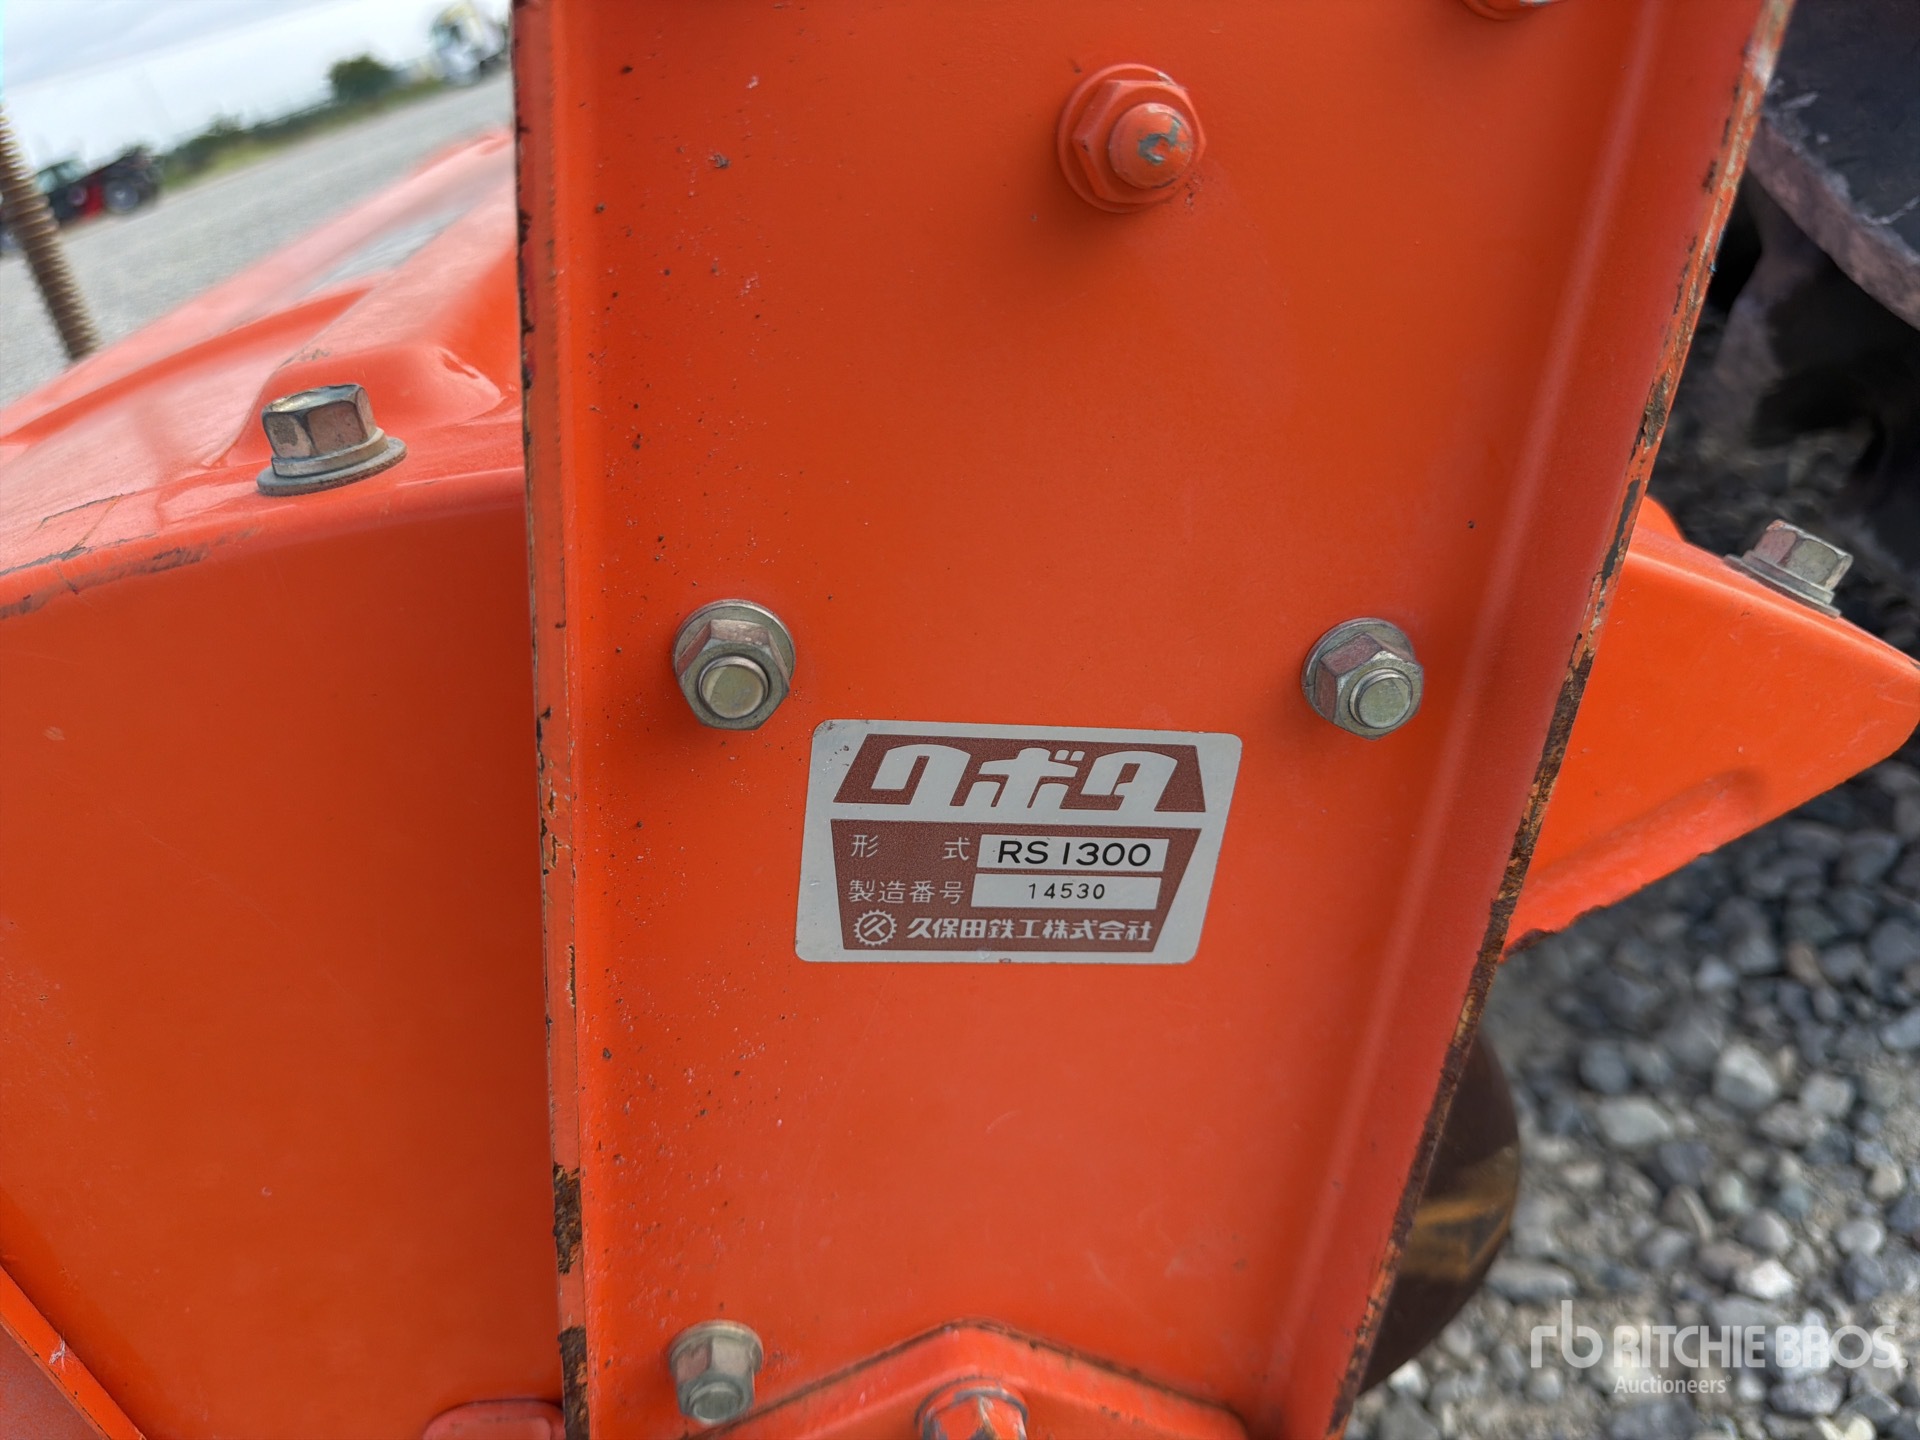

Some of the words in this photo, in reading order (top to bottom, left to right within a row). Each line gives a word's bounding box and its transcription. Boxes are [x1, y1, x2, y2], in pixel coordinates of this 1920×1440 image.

[871, 743, 1178, 811] クボタ
[848, 880, 964, 905] 製造番号
[1029, 883, 1105, 900] 14530
[907, 918, 1153, 941] 久保田鉄工株式会社
